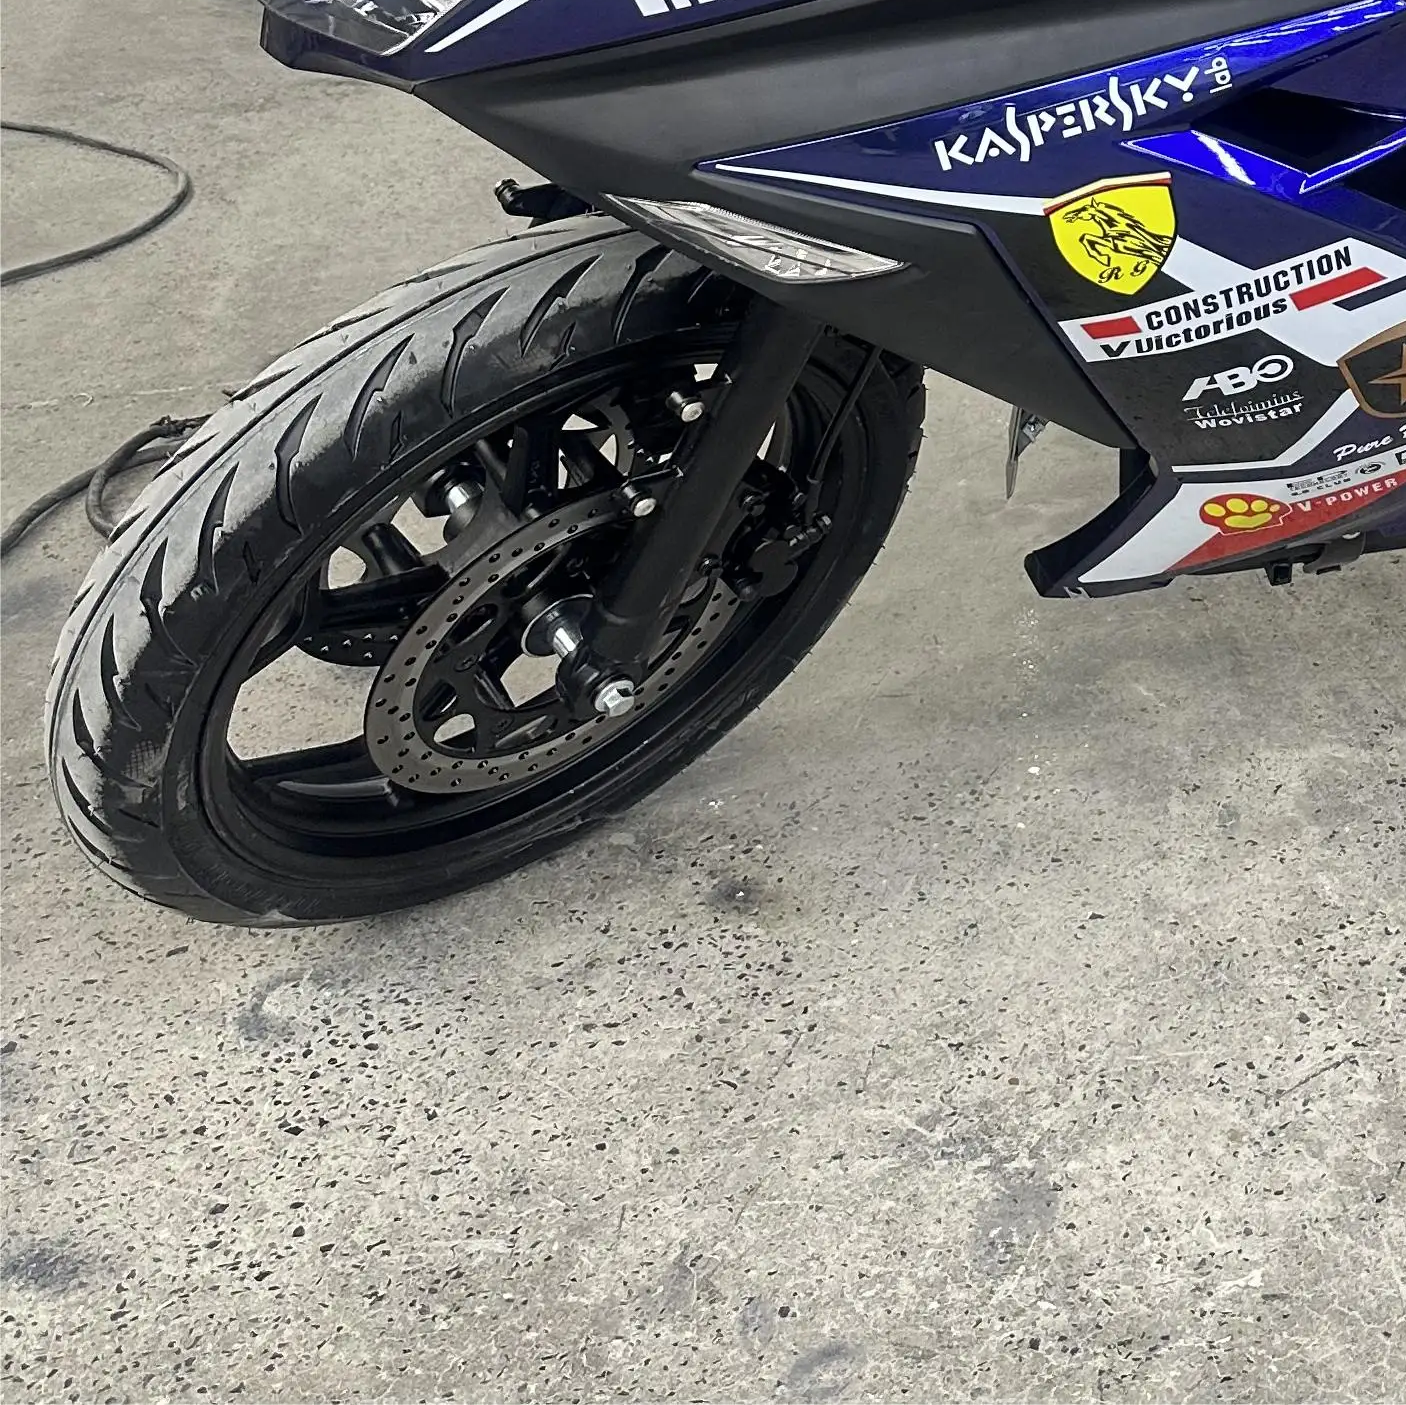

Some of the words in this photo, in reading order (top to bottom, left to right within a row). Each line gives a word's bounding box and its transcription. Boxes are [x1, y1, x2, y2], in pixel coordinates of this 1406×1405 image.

[934, 65, 1201, 172] KASPERSKY
[1203, 55, 1233, 95] lab
[1144, 245, 1353, 331] CONSTRUCTION
[1193, 402, 1304, 430] Wovistar
[1332, 435, 1395, 462] Pure
[1296, 477, 1400, 513] V-POWER
